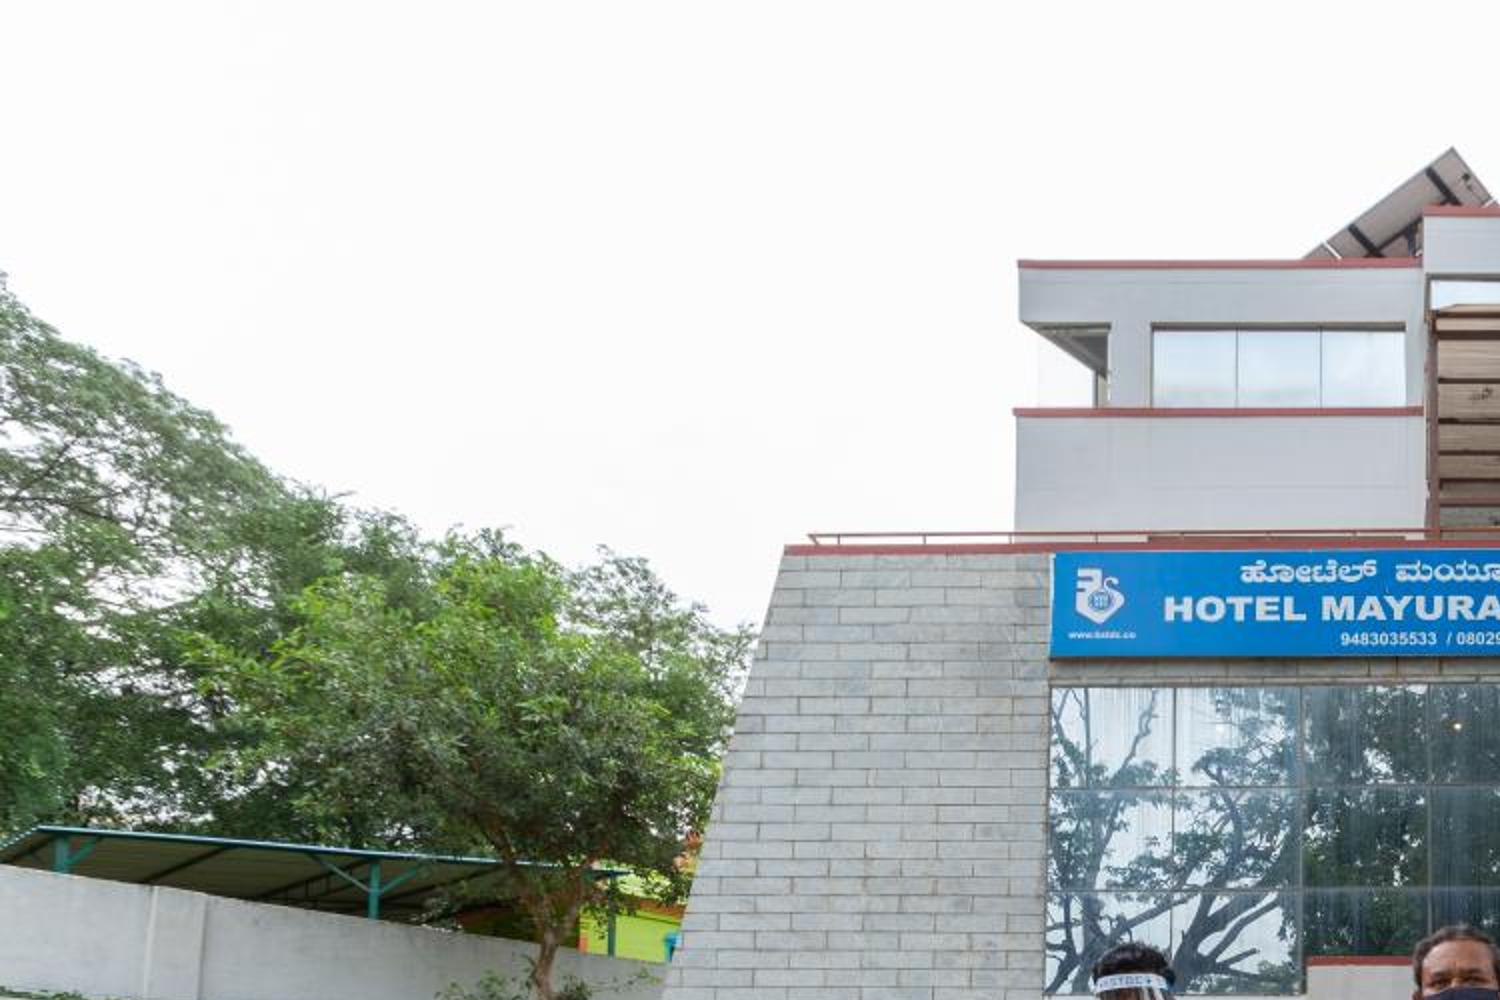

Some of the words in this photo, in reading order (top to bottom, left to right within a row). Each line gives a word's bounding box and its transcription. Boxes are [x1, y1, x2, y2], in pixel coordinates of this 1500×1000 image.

[1240, 559, 1377, 583] ಹೋಟೆಲ್
[1163, 595, 1307, 622] HOTEL
[1340, 631, 1438, 646] 9483035533
